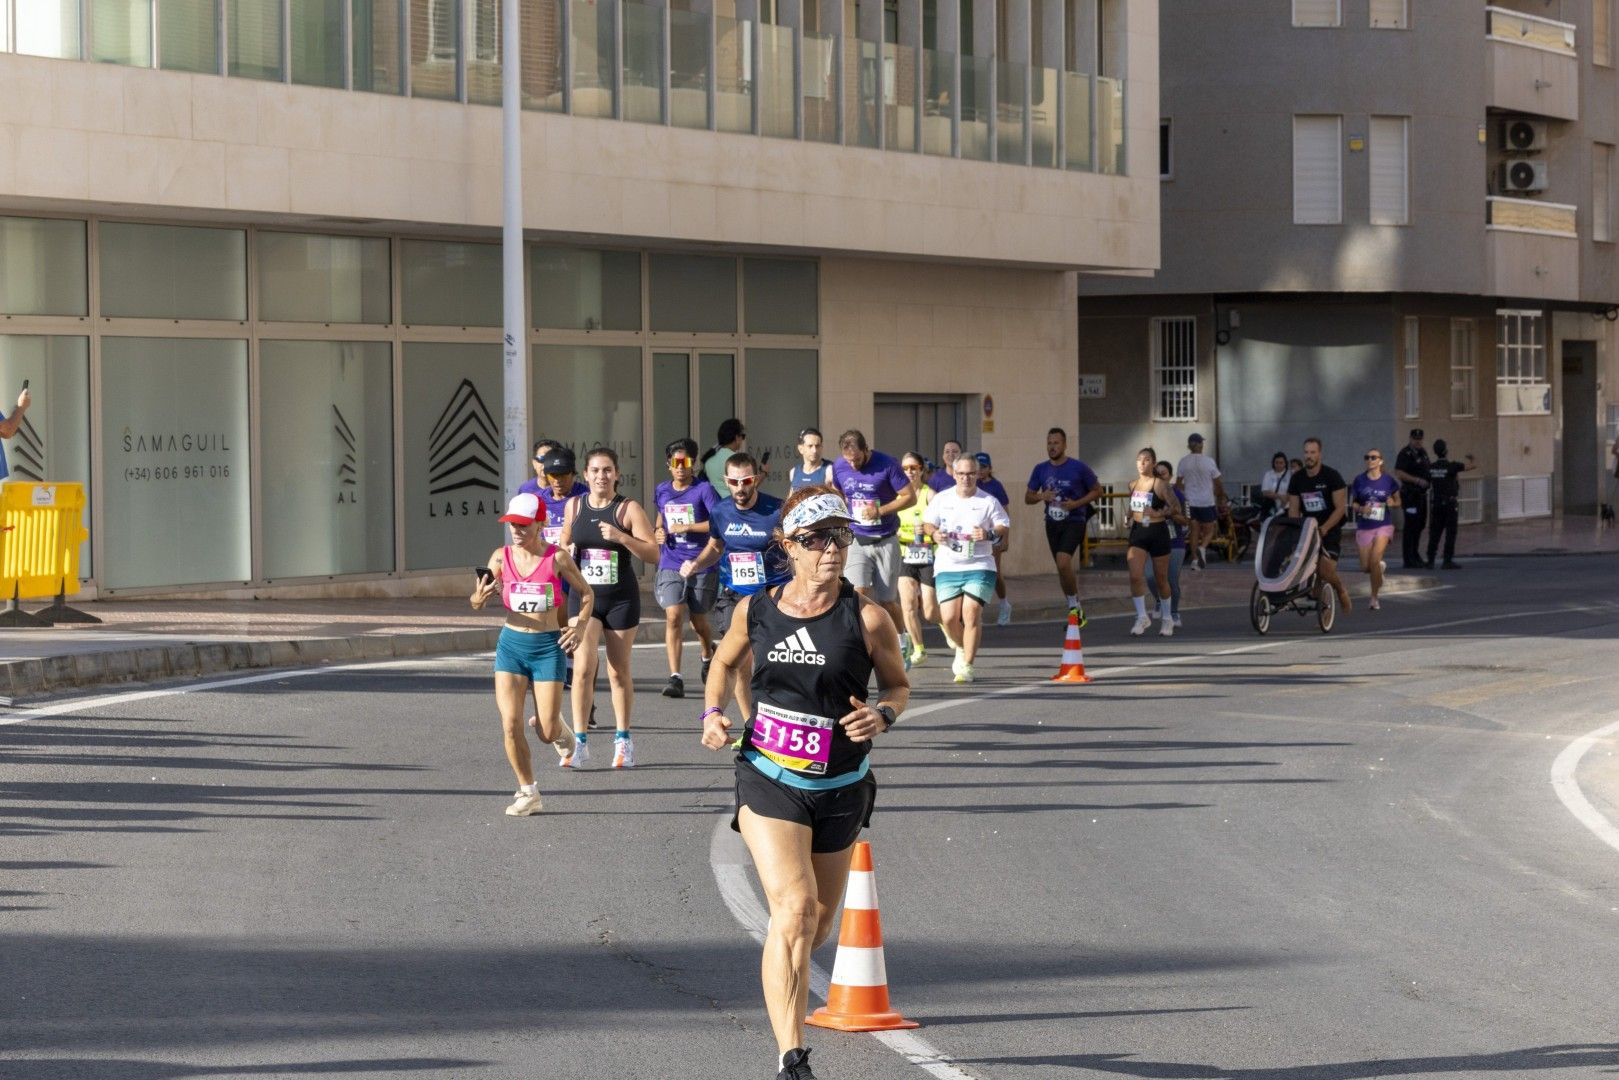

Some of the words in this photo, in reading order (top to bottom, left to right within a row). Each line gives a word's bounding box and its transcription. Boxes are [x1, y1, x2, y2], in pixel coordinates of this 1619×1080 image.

[123, 433, 230, 453] SAMAGUIL
[125, 467, 151, 482] (+34)
[155, 466, 178, 480] 606
[184, 465, 204, 479] 961
[209, 465, 230, 478] 016
[430, 499, 500, 517] LASAL
[587, 565, 604, 577] 33
[734, 567, 756, 578] 165
[518, 601, 539, 613] 47
[767, 648, 826, 666] adidas
[761, 718, 821, 755] 1158
